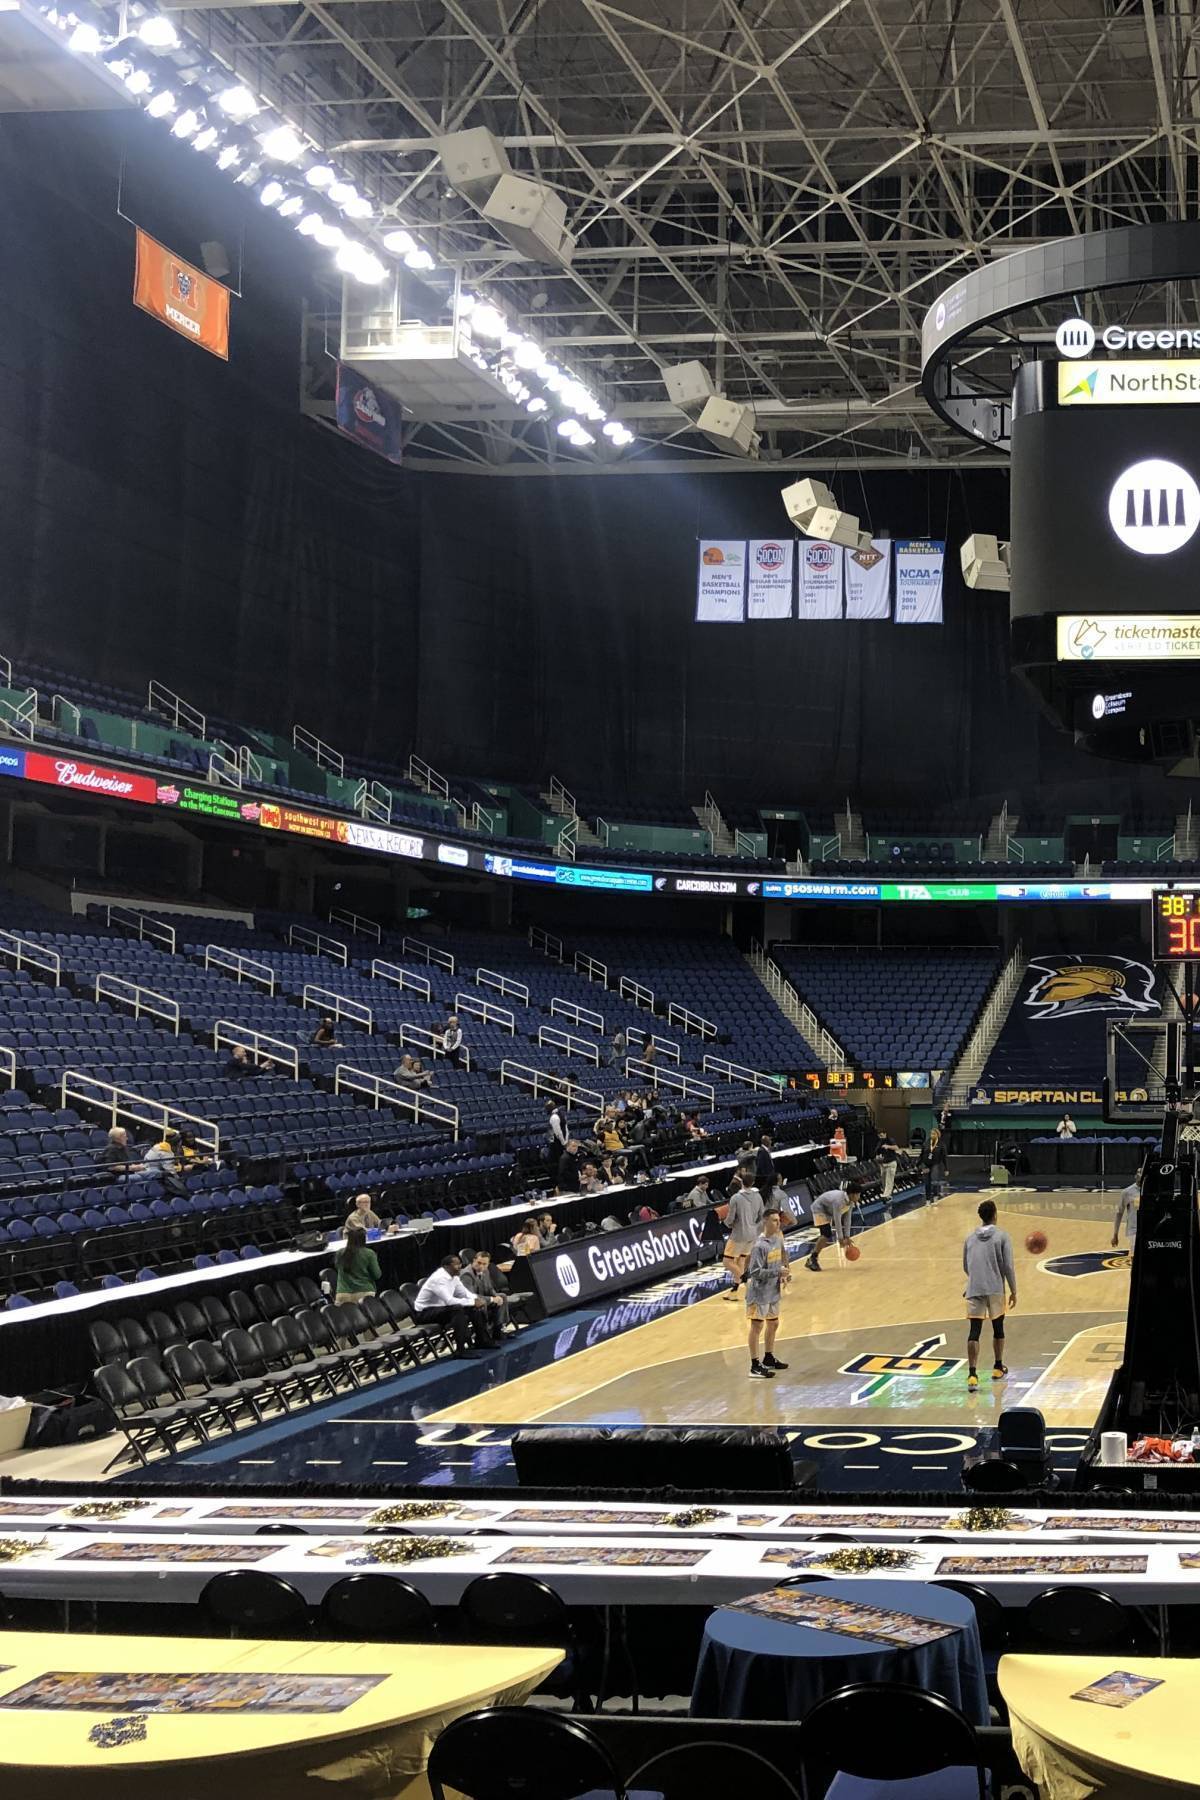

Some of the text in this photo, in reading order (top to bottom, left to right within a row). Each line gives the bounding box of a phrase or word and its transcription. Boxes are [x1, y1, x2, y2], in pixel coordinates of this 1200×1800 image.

[900, 569, 930, 578] NCAA
[55, 762, 132, 793] Budweiser
[284, 812, 319, 827] southwest
[320, 819, 335, 831] grill
[676, 880, 737, 893] CARCOBRAS.COM
[784, 885, 878, 896] gsoswarm.com
[897, 886, 932, 899] TFA
[828, 1073, 853, 1083] 38:13
[994, 1091, 1078, 1103] SPARTAN
[1148, 1240, 1182, 1249] SPALDING
[589, 1227, 690, 1282] Greensboro
